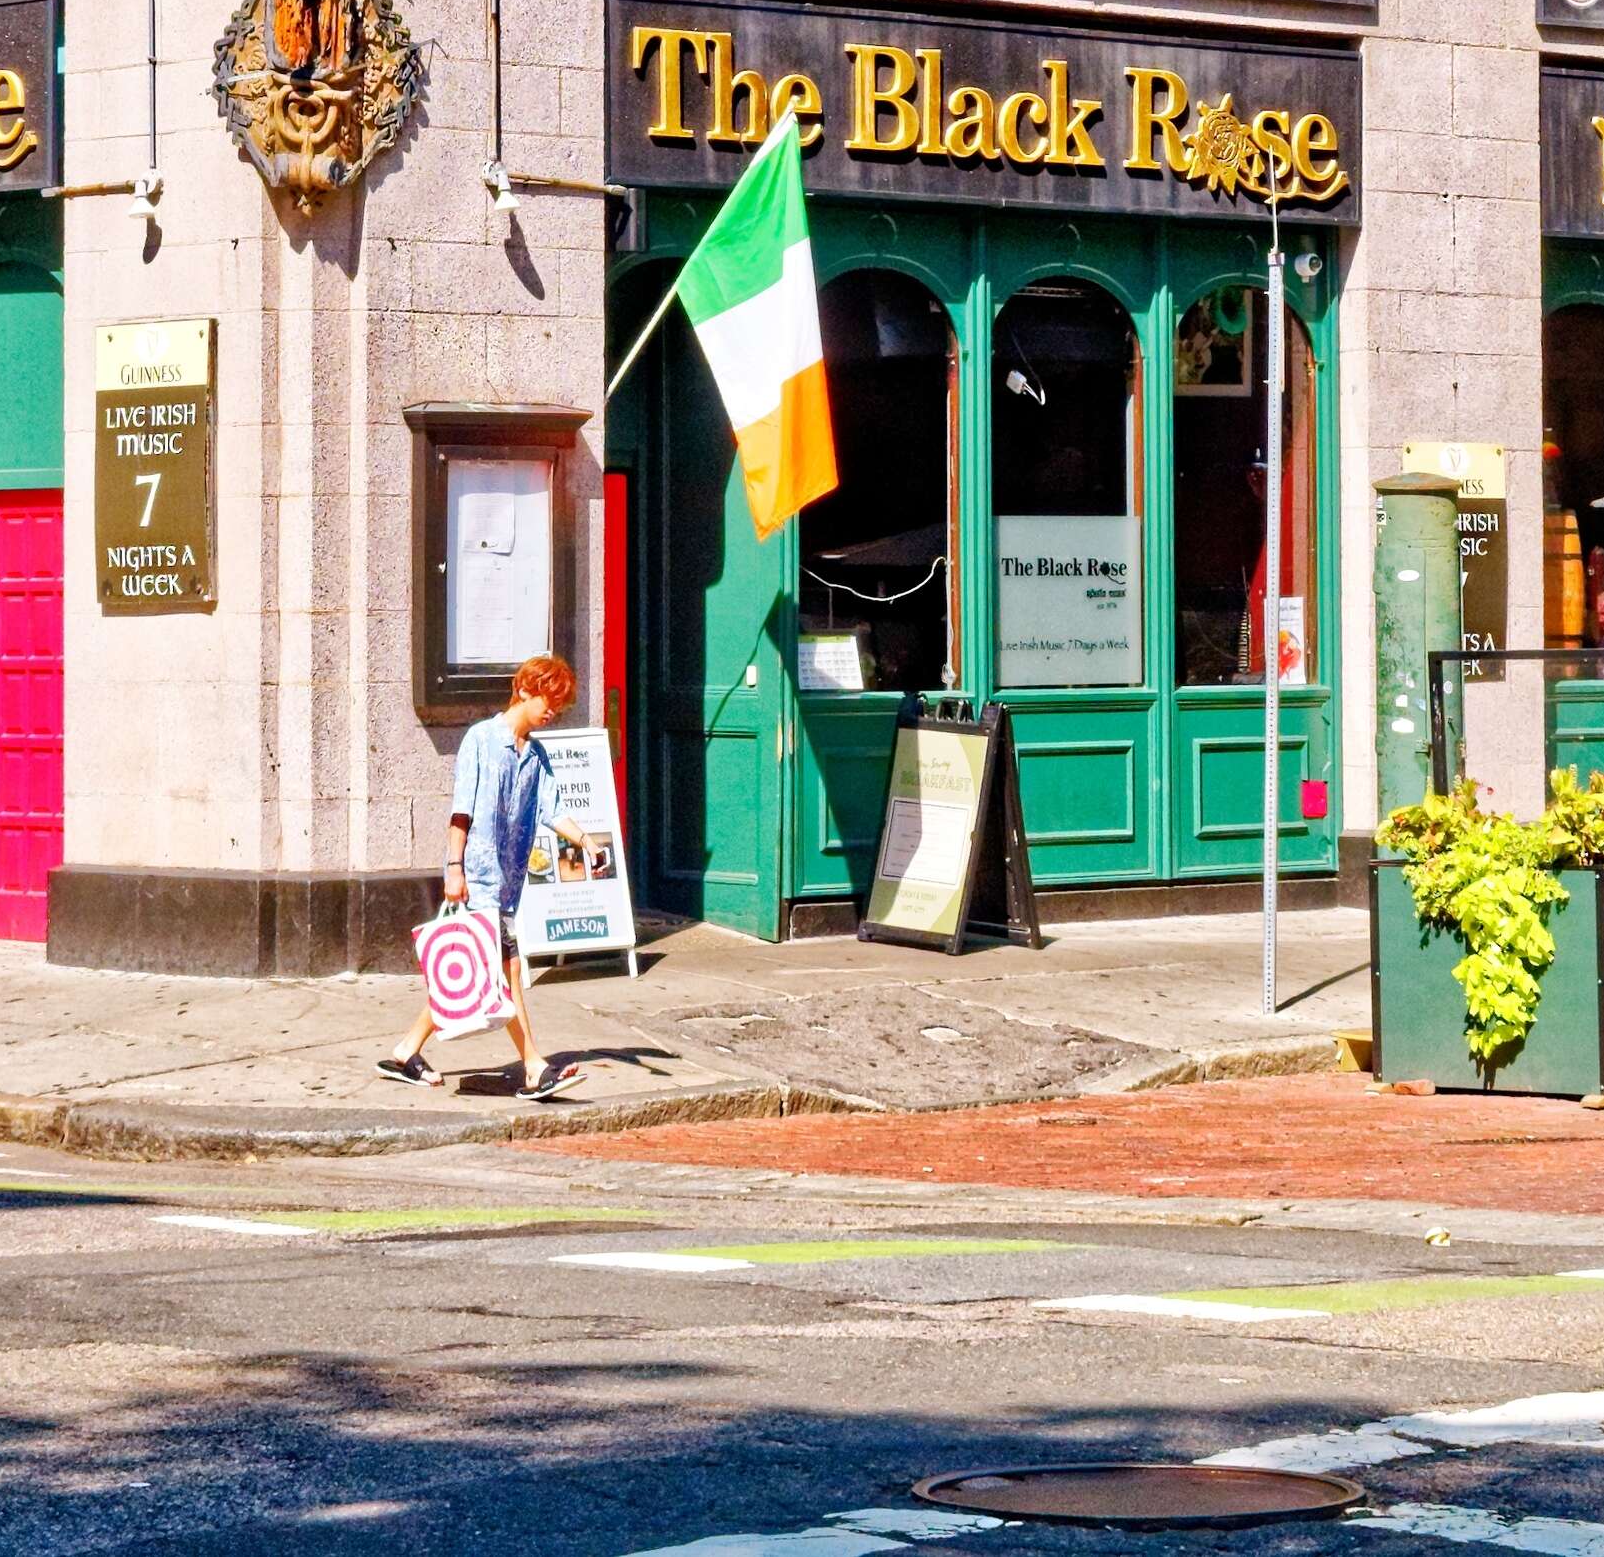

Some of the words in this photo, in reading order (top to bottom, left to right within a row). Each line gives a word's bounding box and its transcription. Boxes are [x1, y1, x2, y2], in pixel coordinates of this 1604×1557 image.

[631, 26, 824, 146] The
[844, 42, 1105, 167] Black
[1124, 65, 1343, 189] Rose
[120, 364, 183, 385] GUINNESS
[105, 407, 146, 430] LIVE
[151, 403, 196, 427] IRISH
[116, 432, 183, 457] MUSIC
[135, 473, 161, 528] 7
[107, 544, 178, 569] NIGHTS
[181, 544, 196, 567] A
[1460, 538, 1488, 556] SIC
[1002, 557, 1033, 576] The
[1037, 557, 1083, 576] Black
[1088, 557, 1127, 578] Rose
[121, 573, 184, 597] WEEK
[570, 782, 591, 794] PUB
[549, 917, 606, 941] JAMESON
